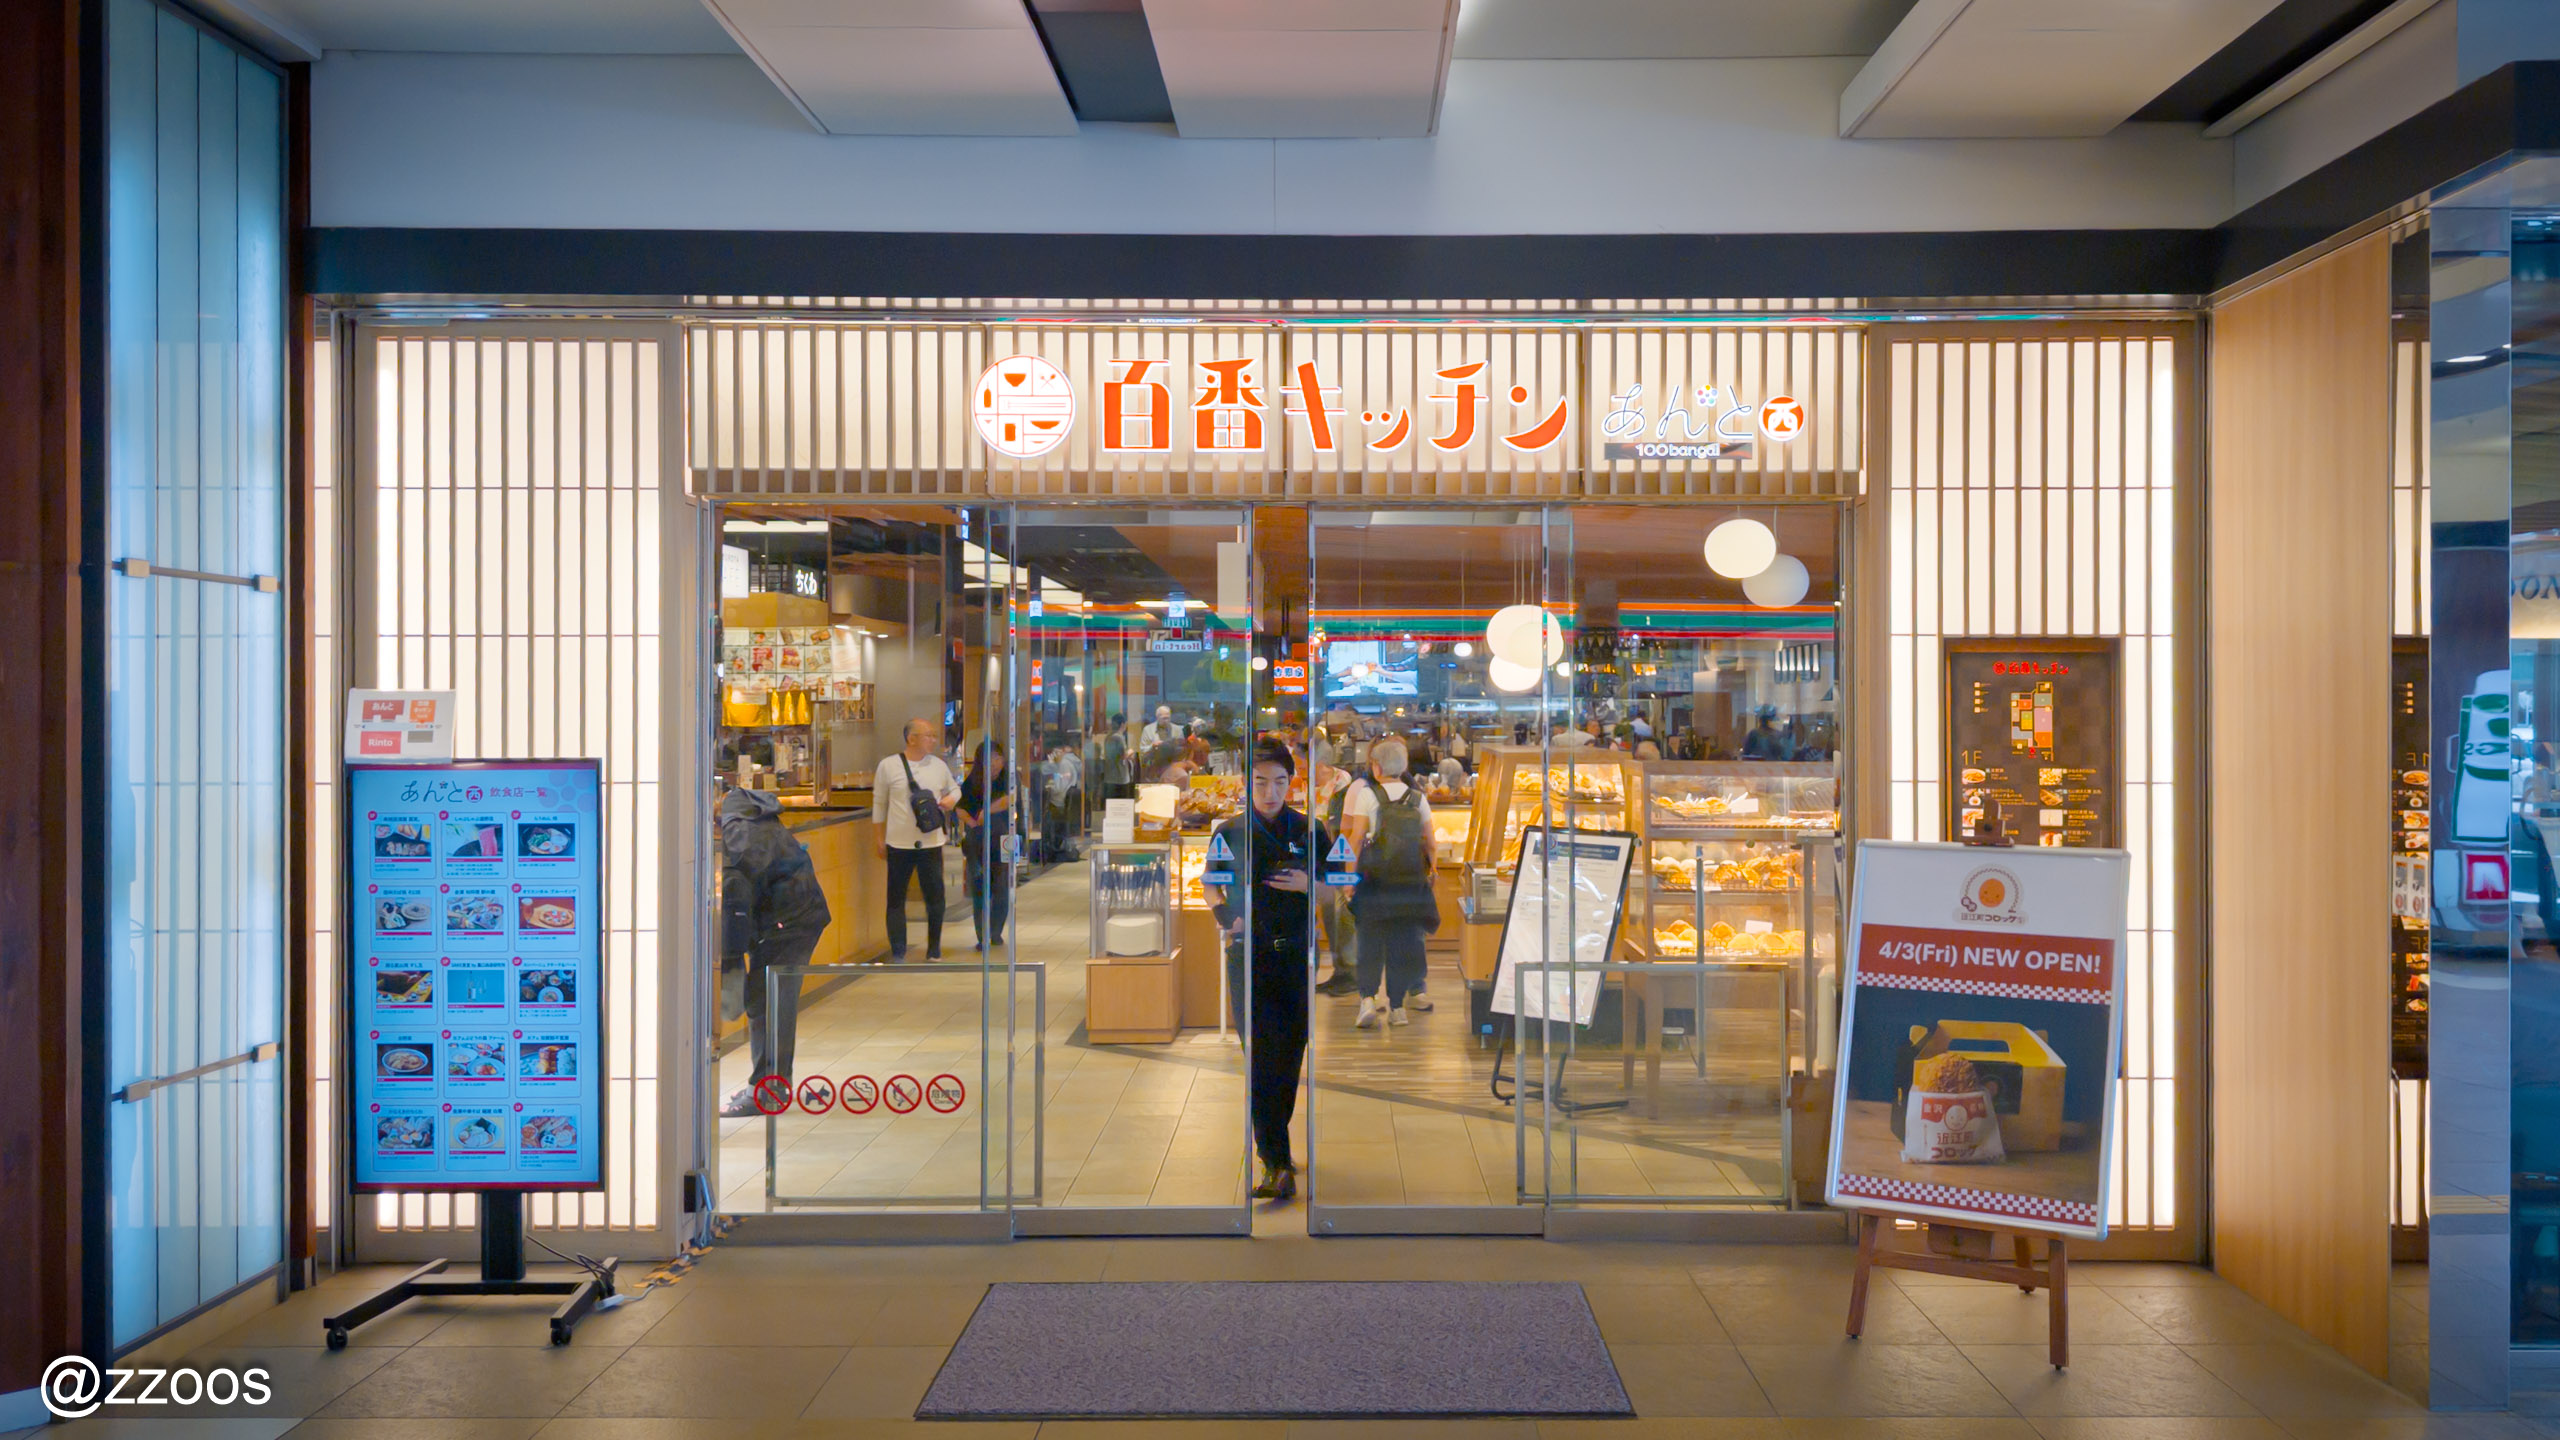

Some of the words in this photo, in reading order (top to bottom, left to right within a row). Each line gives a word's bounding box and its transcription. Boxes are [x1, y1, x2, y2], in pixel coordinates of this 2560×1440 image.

[1102, 358, 1569, 452] 百番キッチン
[796, 568, 817, 595] ちくわ
[368, 738, 393, 747] Rinto
[1962, 750, 1983, 766] 1F
[490, 786, 547, 798] 飲食店一覧
[1879, 941, 1958, 967] 4/3(Fri)
[1963, 946, 2020, 968] NEW
[2025, 950, 2101, 974] OPEN!
